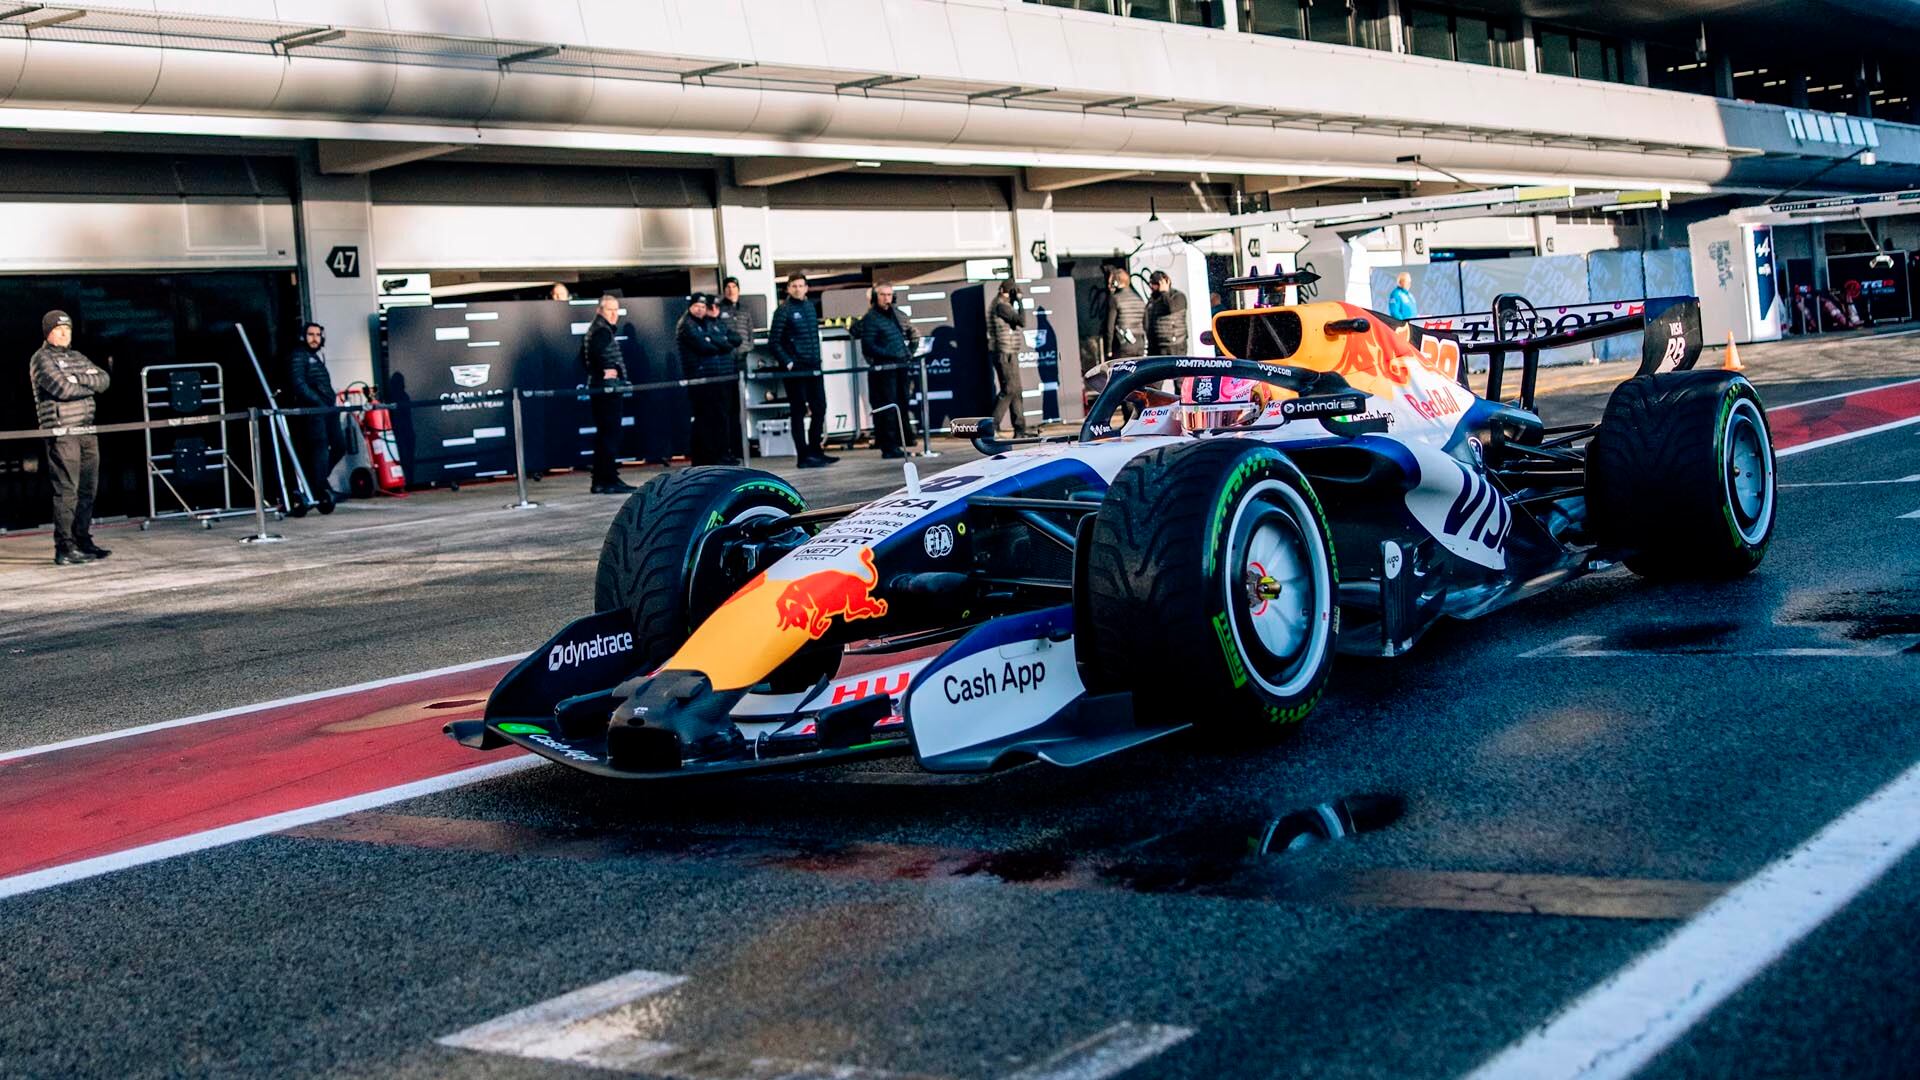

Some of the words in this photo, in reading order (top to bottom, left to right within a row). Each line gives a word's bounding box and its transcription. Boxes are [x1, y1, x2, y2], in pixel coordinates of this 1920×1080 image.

[333, 251, 356, 273] 47
[743, 247, 760, 268] 46
[1669, 322, 1683, 336] VISA
[1142, 409, 1168, 417] Mobil
[1296, 400, 1340, 413] hahnair
[835, 414, 848, 429] 77
[801, 547, 842, 555] NEFT
[564, 631, 634, 667] dynatrace
[943, 661, 997, 705] Cash
[1000, 661, 1046, 694] App
